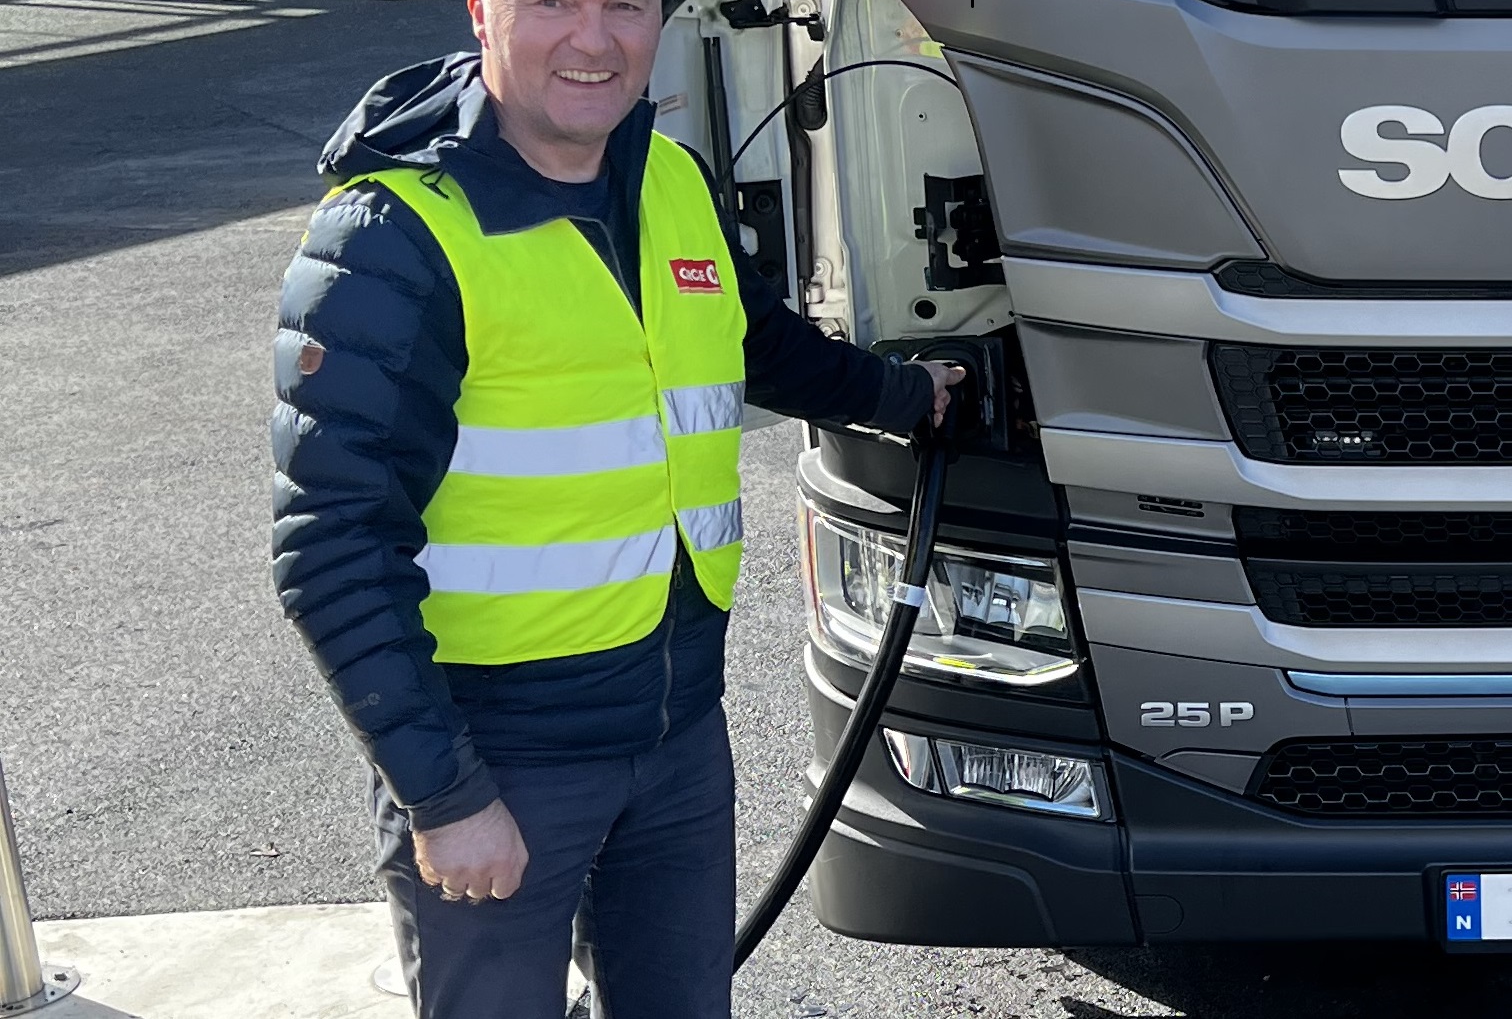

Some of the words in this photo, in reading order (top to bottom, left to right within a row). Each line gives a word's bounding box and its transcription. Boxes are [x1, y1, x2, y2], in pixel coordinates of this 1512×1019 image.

[1140, 701, 1211, 727] 25
[1219, 701, 1254, 727] P
[1456, 915, 1472, 931] N
